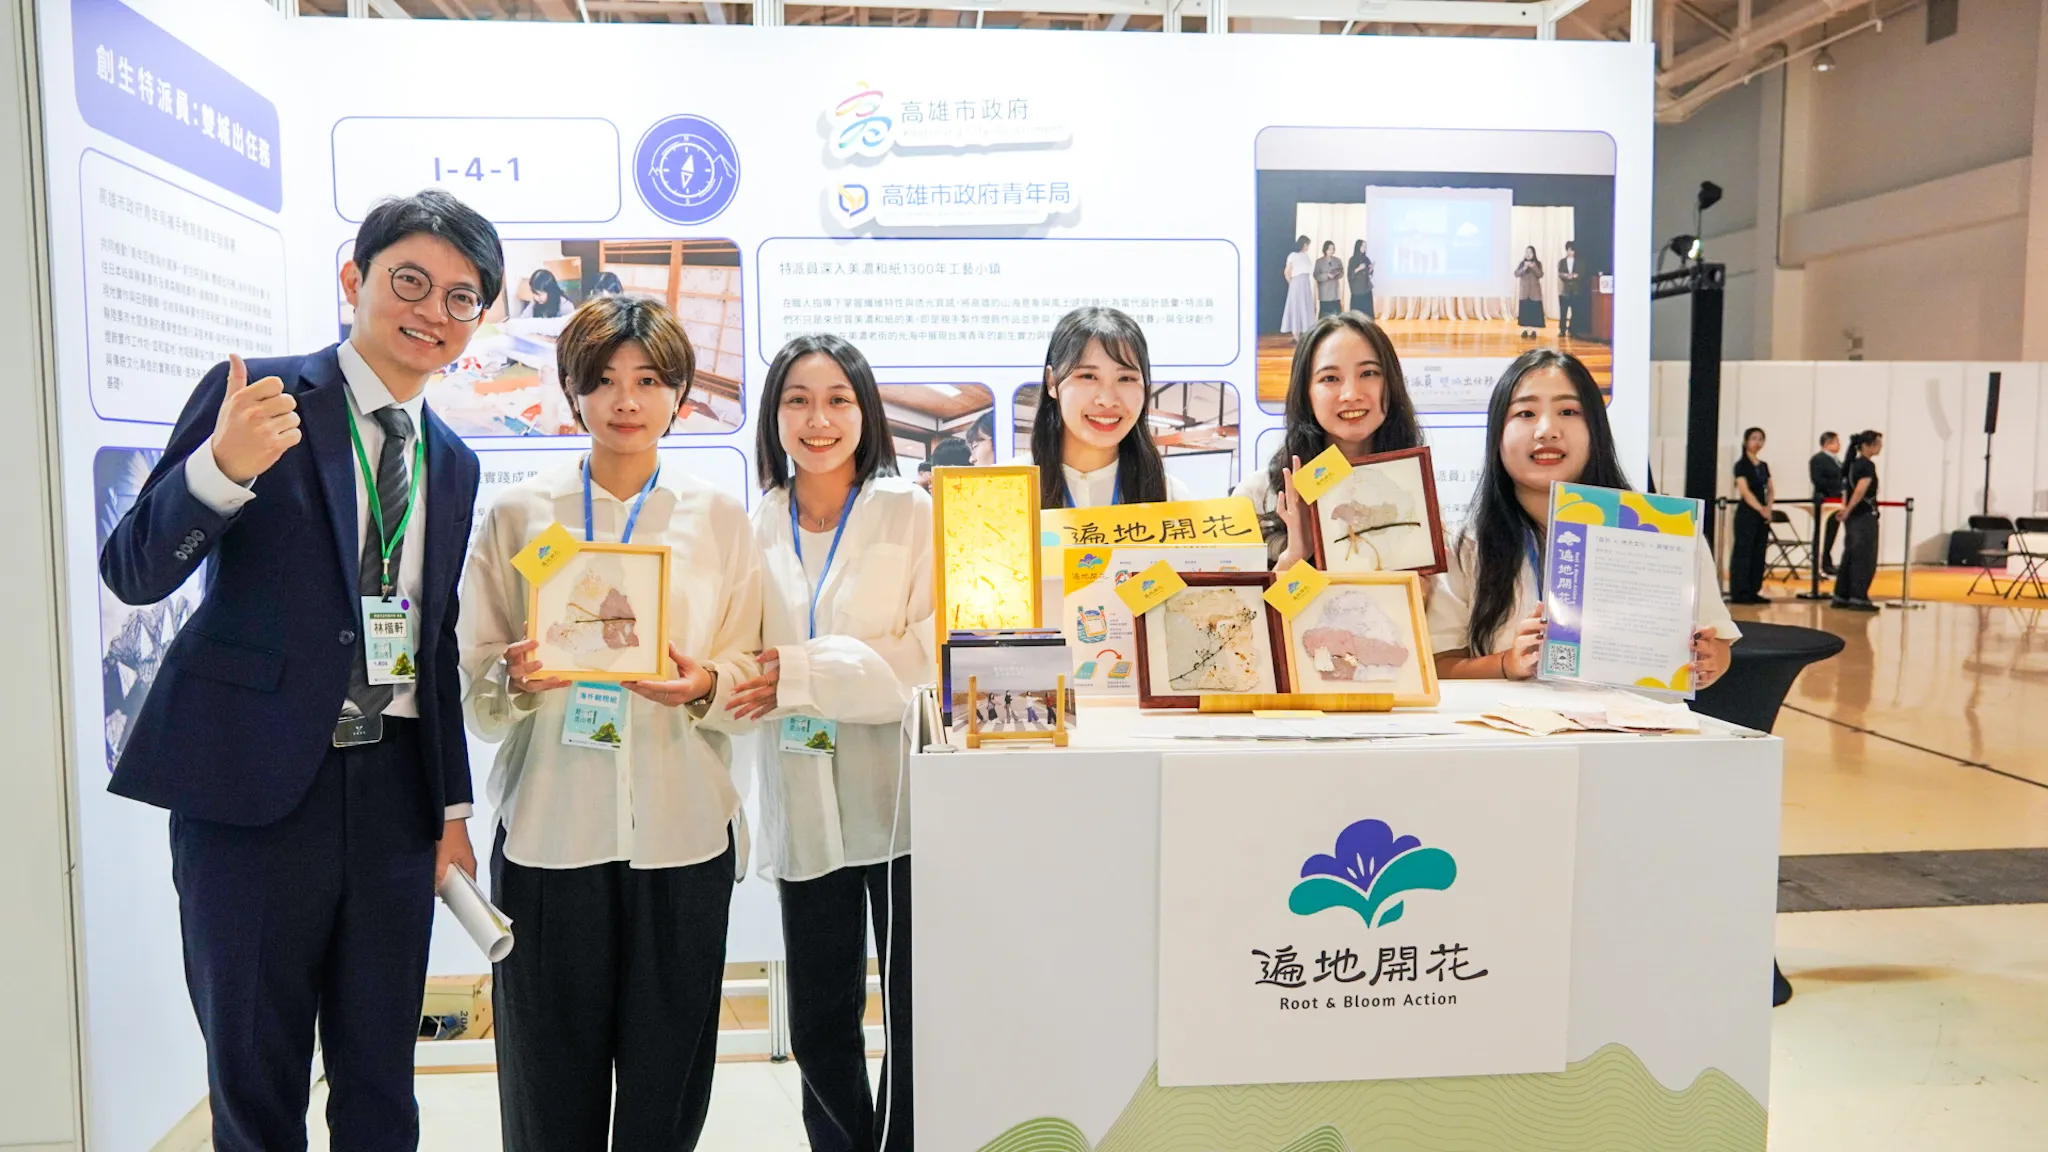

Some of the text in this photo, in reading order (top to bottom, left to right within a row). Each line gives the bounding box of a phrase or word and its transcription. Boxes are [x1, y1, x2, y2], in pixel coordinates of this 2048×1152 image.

[901, 98, 1029, 123] 高雄市政府
[882, 182, 1071, 206] 高雄市政府青年局
[779, 262, 1001, 276] 特派員深入美濃和紙1300年工藝小鎮
[1063, 515, 1252, 545] 遍地開花
[1251, 943, 1489, 989] 遍地開花
[1280, 992, 1457, 1010] Root & Bloom Action
